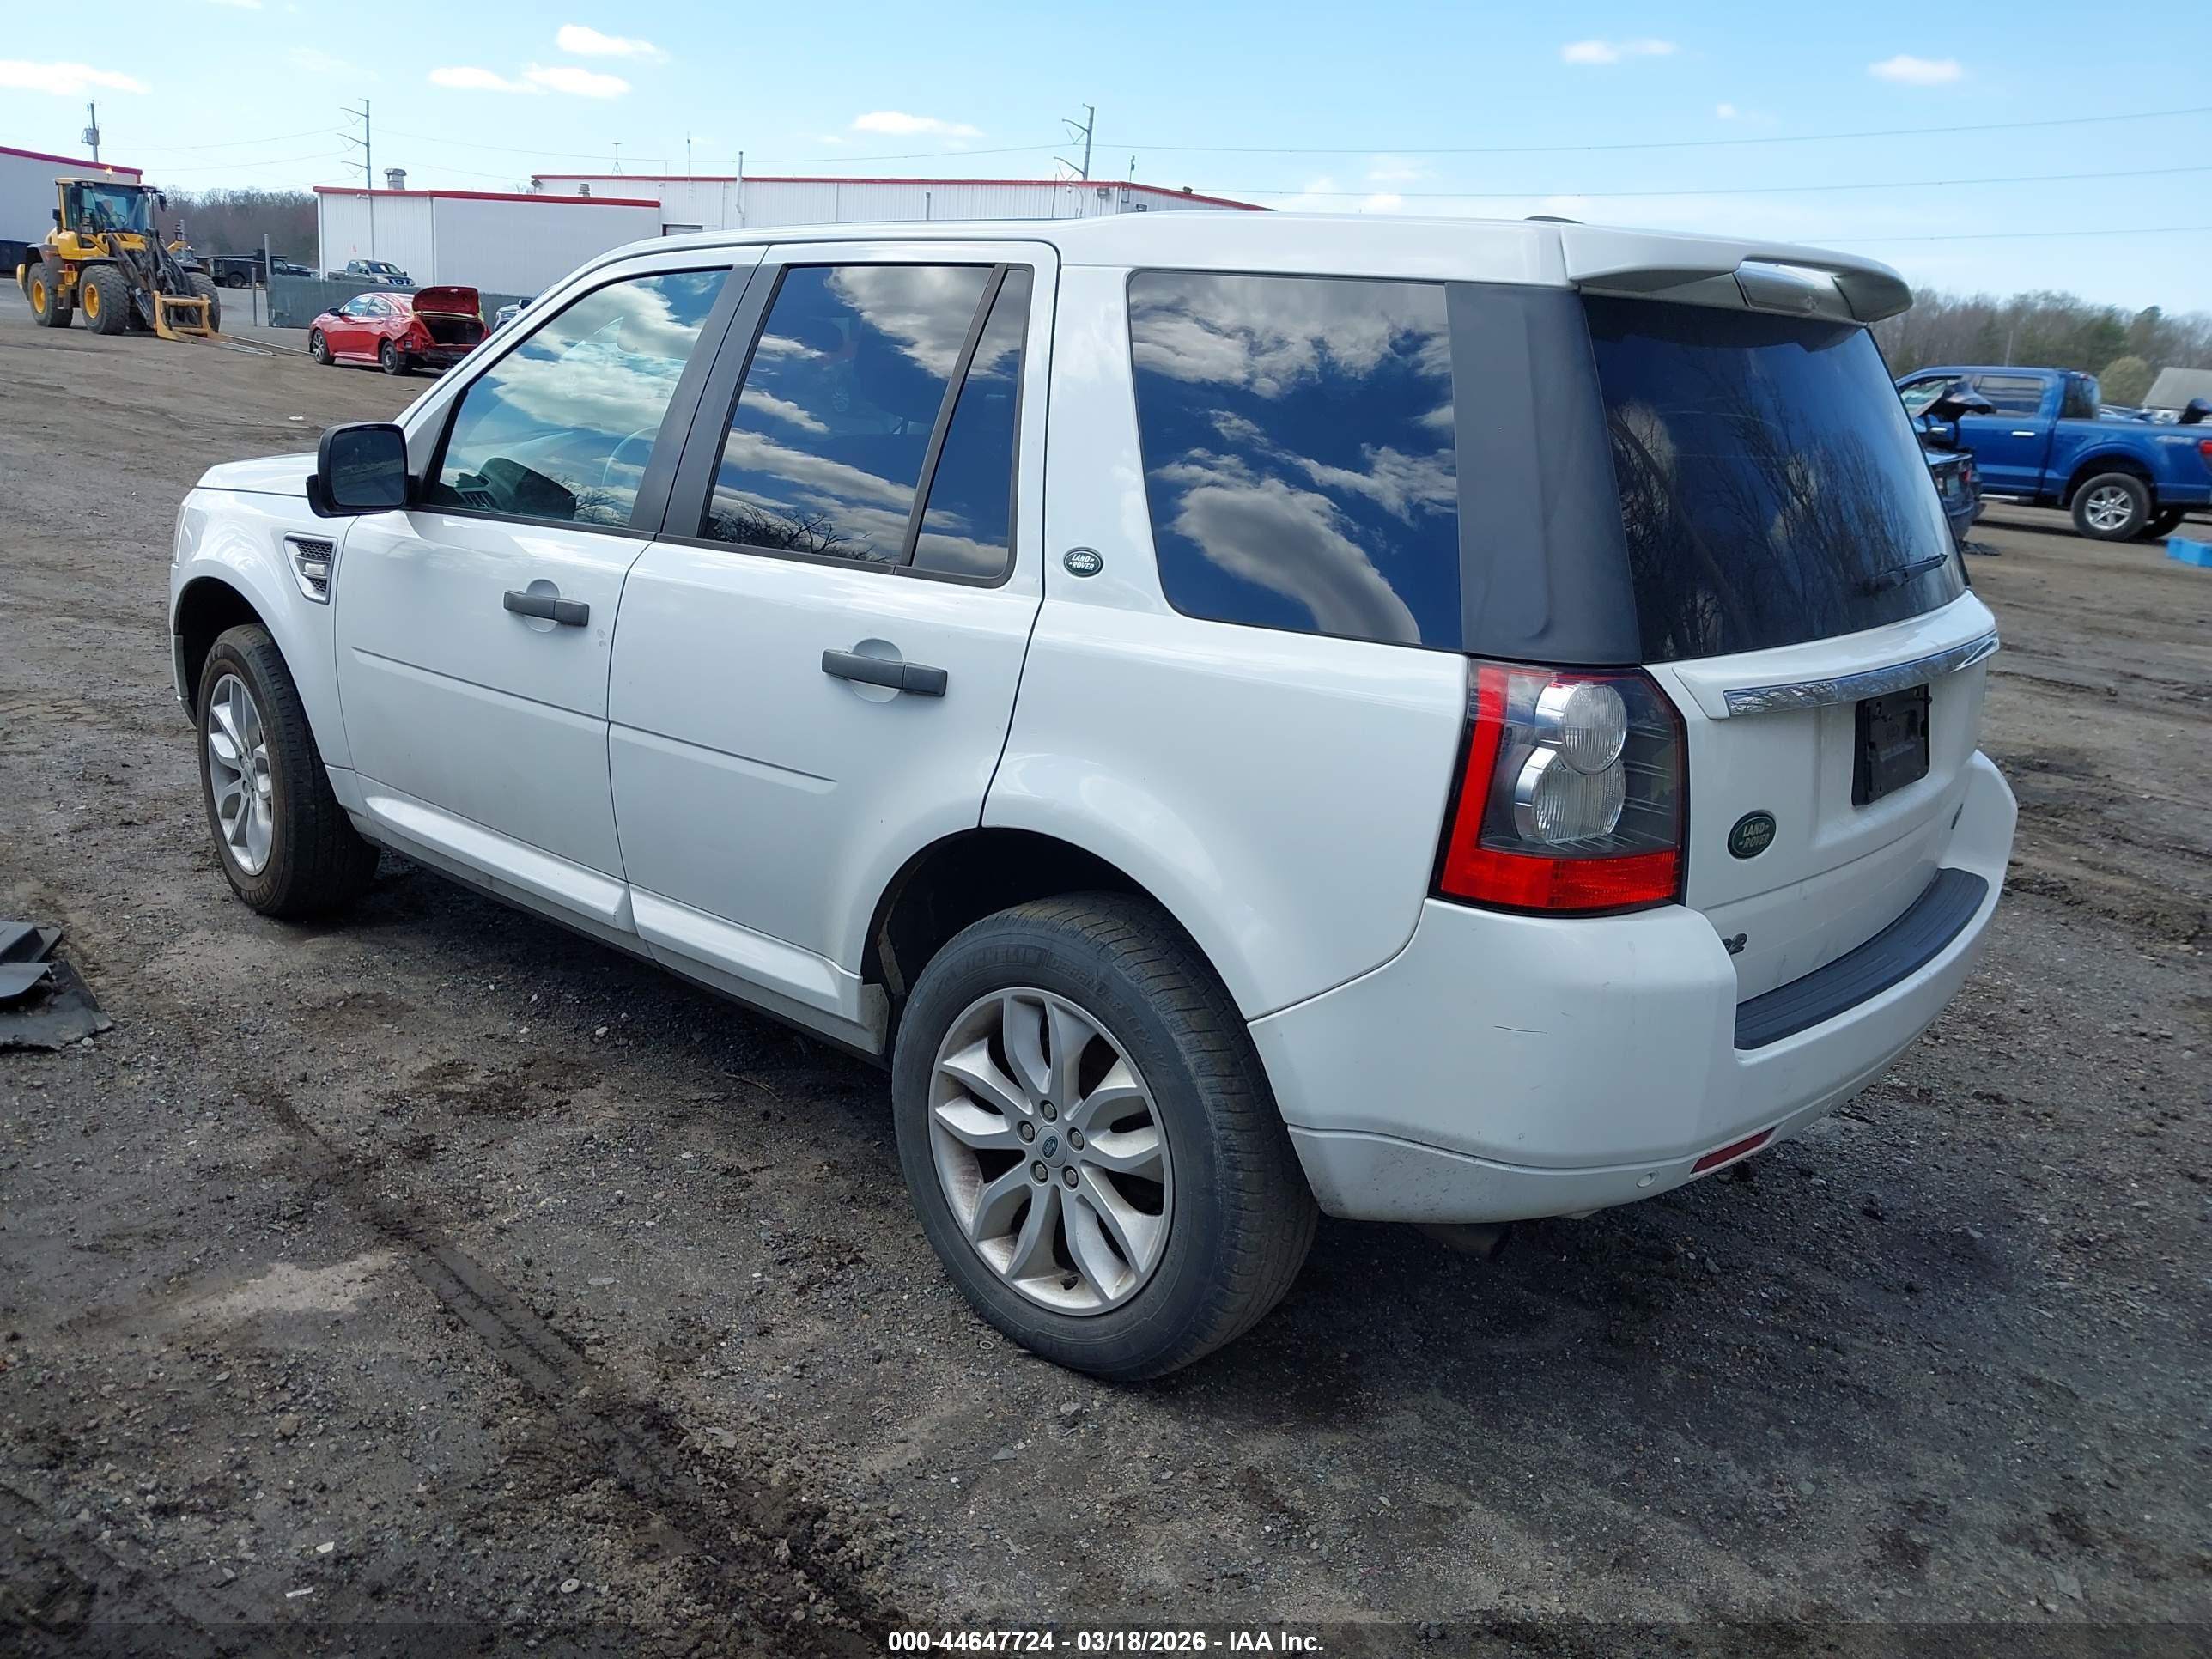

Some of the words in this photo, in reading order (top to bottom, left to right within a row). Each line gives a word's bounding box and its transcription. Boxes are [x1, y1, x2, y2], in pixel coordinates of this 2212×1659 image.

[1072, 554, 1091, 562] LAND
[1071, 562, 1095, 570] ROVER
[1743, 822, 1766, 836] LAND
[1742, 832, 1771, 848] ROVER
